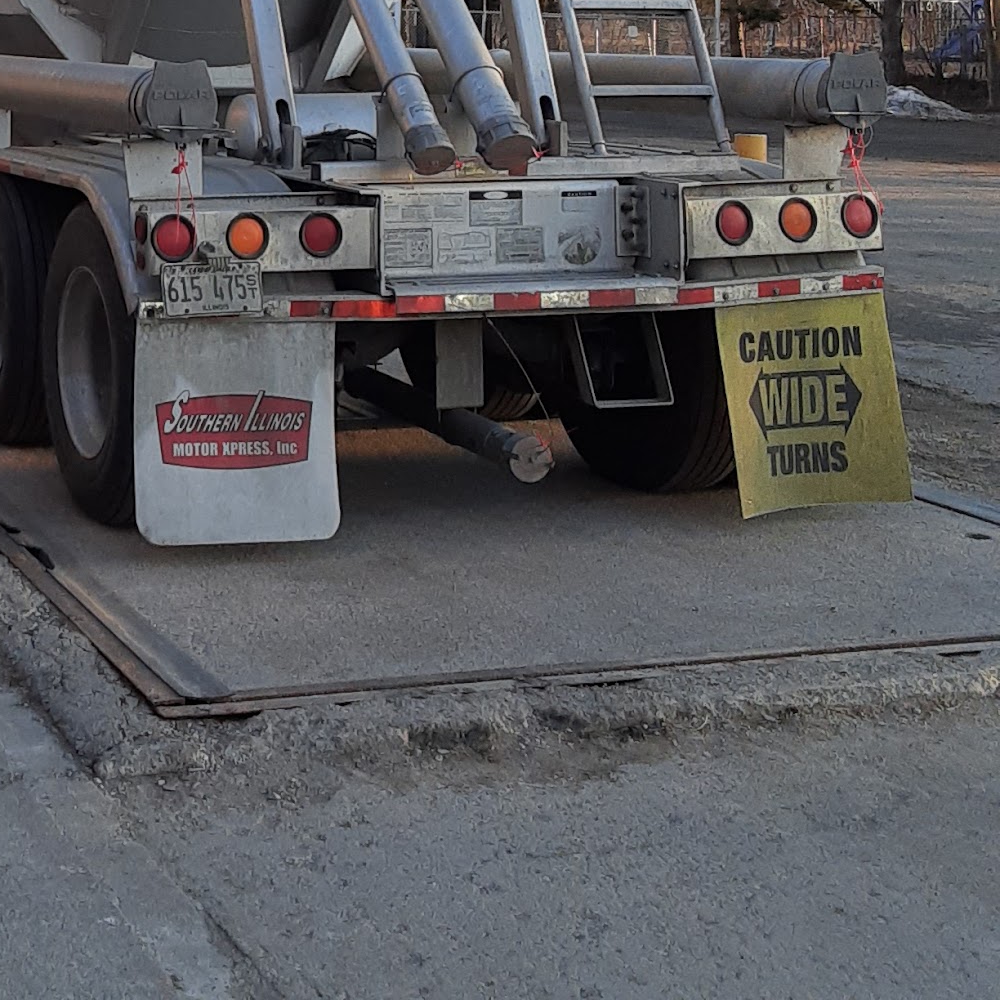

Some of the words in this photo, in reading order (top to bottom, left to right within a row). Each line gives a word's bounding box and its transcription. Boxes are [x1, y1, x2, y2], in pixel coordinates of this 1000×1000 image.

[168, 276, 203, 302] 615
[213, 275, 246, 302] 475
[739, 326, 862, 363] CAUTION
[164, 390, 243, 434] SOUTHERN
[243, 390, 306, 432] ILLINOIS
[758, 374, 850, 427] WIDE
[173, 442, 218, 457] MOTOR
[277, 440, 298, 455] Inc
[767, 441, 849, 477] TURNS
